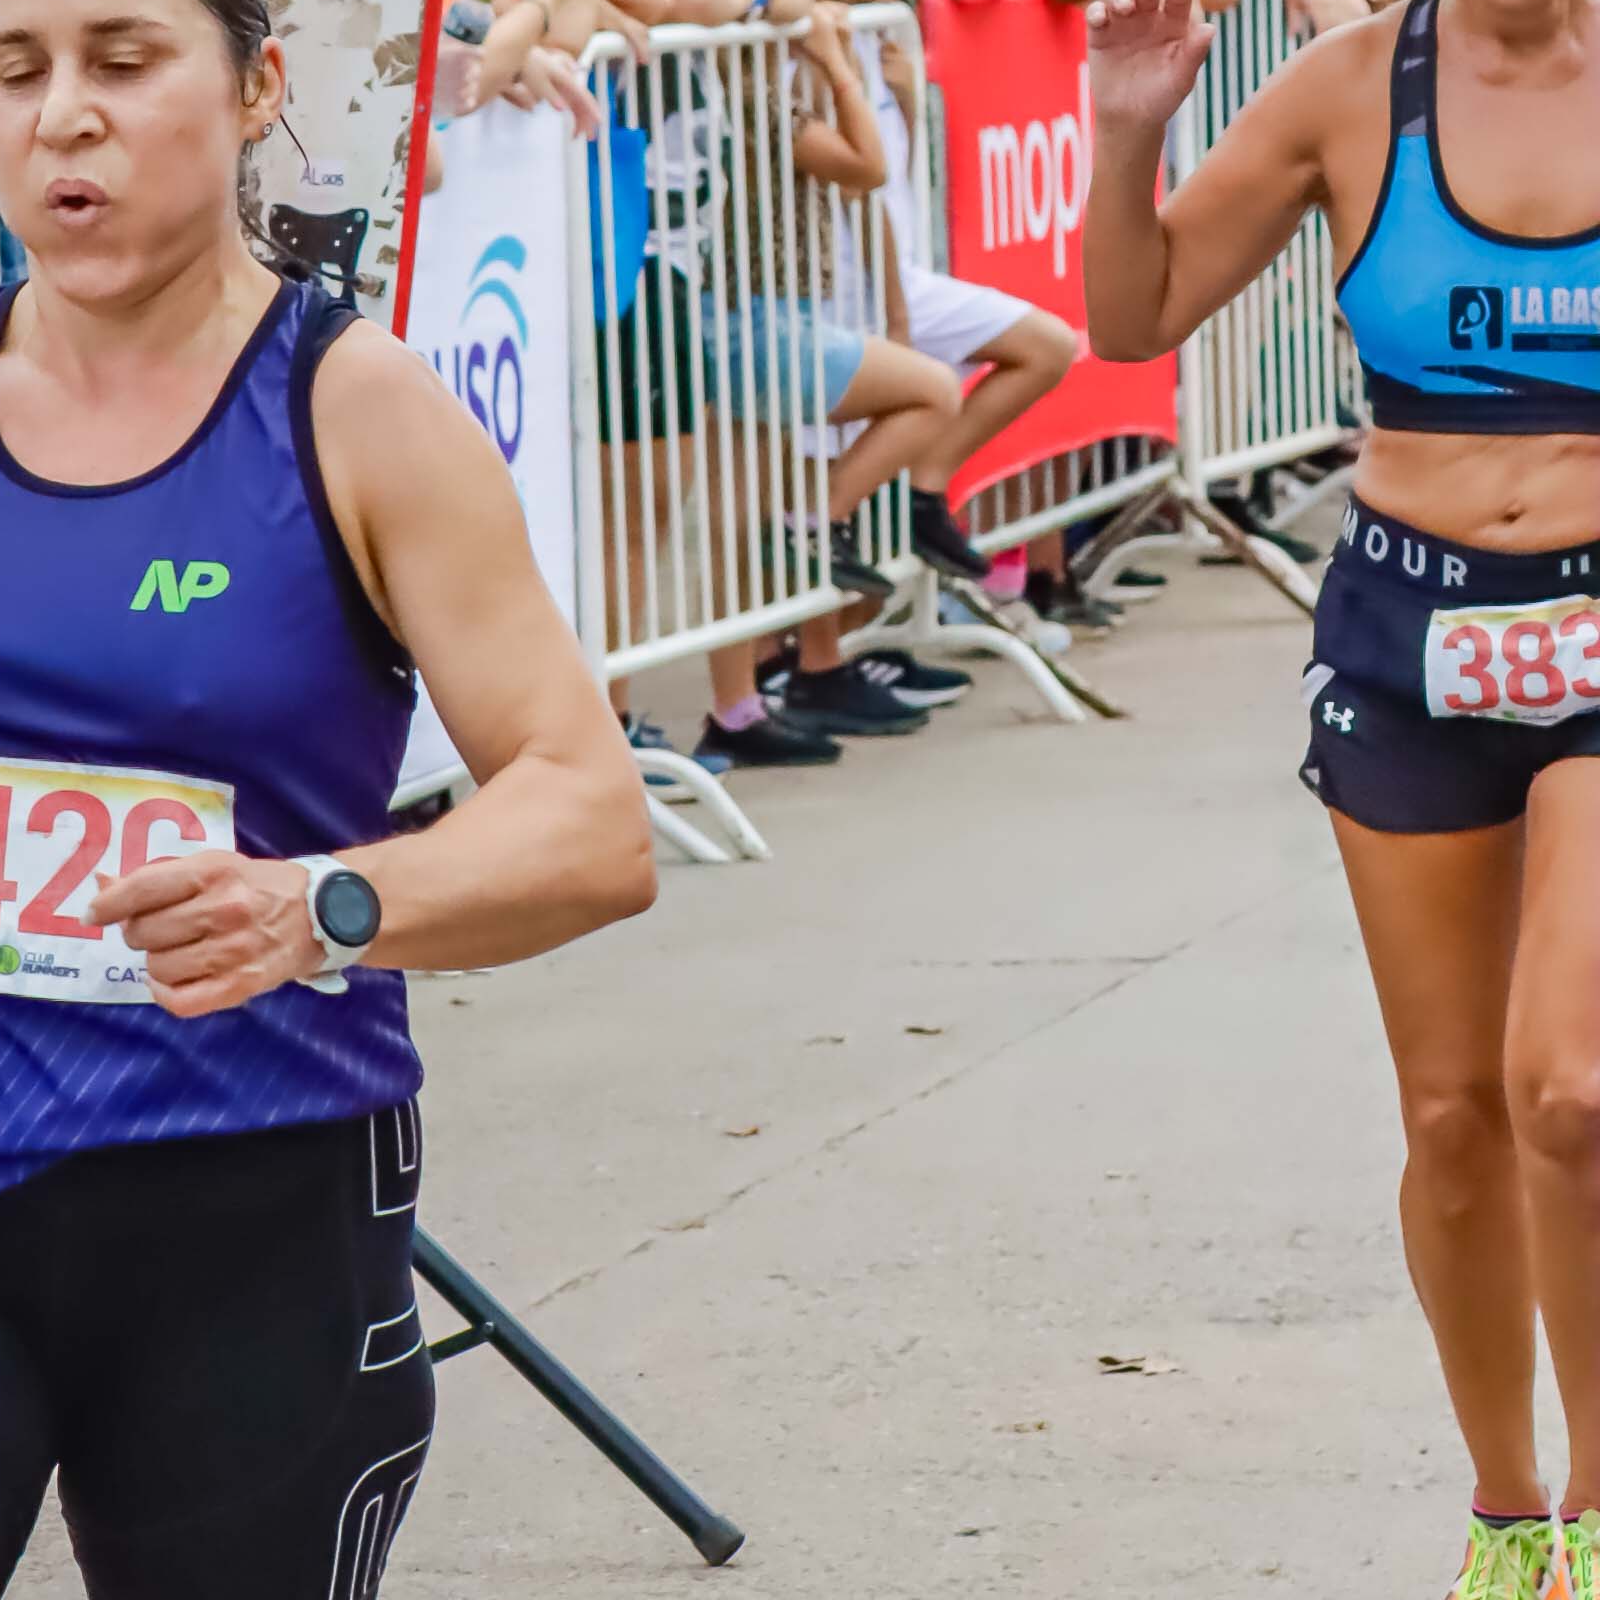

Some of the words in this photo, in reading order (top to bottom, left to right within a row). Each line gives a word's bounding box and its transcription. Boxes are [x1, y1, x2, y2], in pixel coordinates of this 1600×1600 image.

[1511, 287, 1544, 324] LA
[1442, 610, 1600, 711] 383
[23, 951, 55, 964] CLUB
